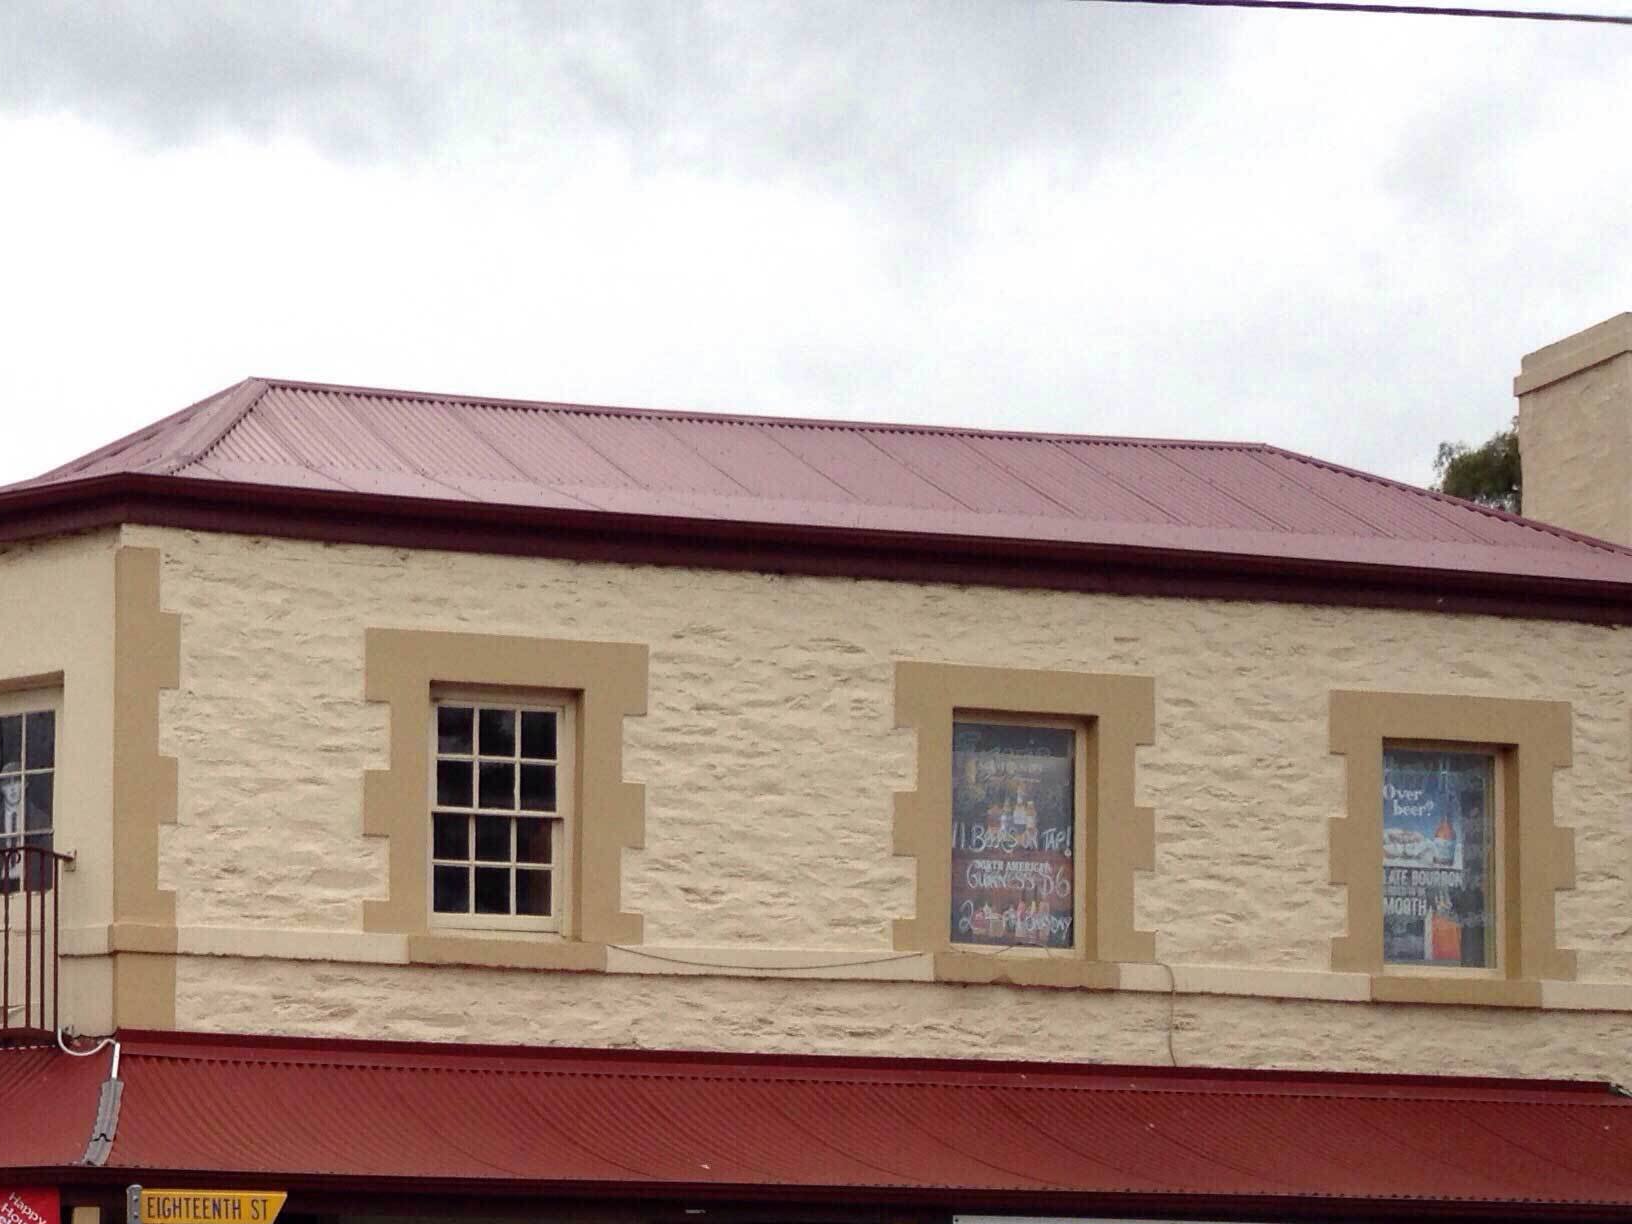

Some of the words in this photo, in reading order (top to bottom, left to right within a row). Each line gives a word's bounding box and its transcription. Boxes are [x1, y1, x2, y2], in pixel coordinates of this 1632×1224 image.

[1393, 800, 1434, 817] beer?
[147, 1197, 242, 1220] EIGHTEENTH
[251, 1199, 267, 1220] ST
